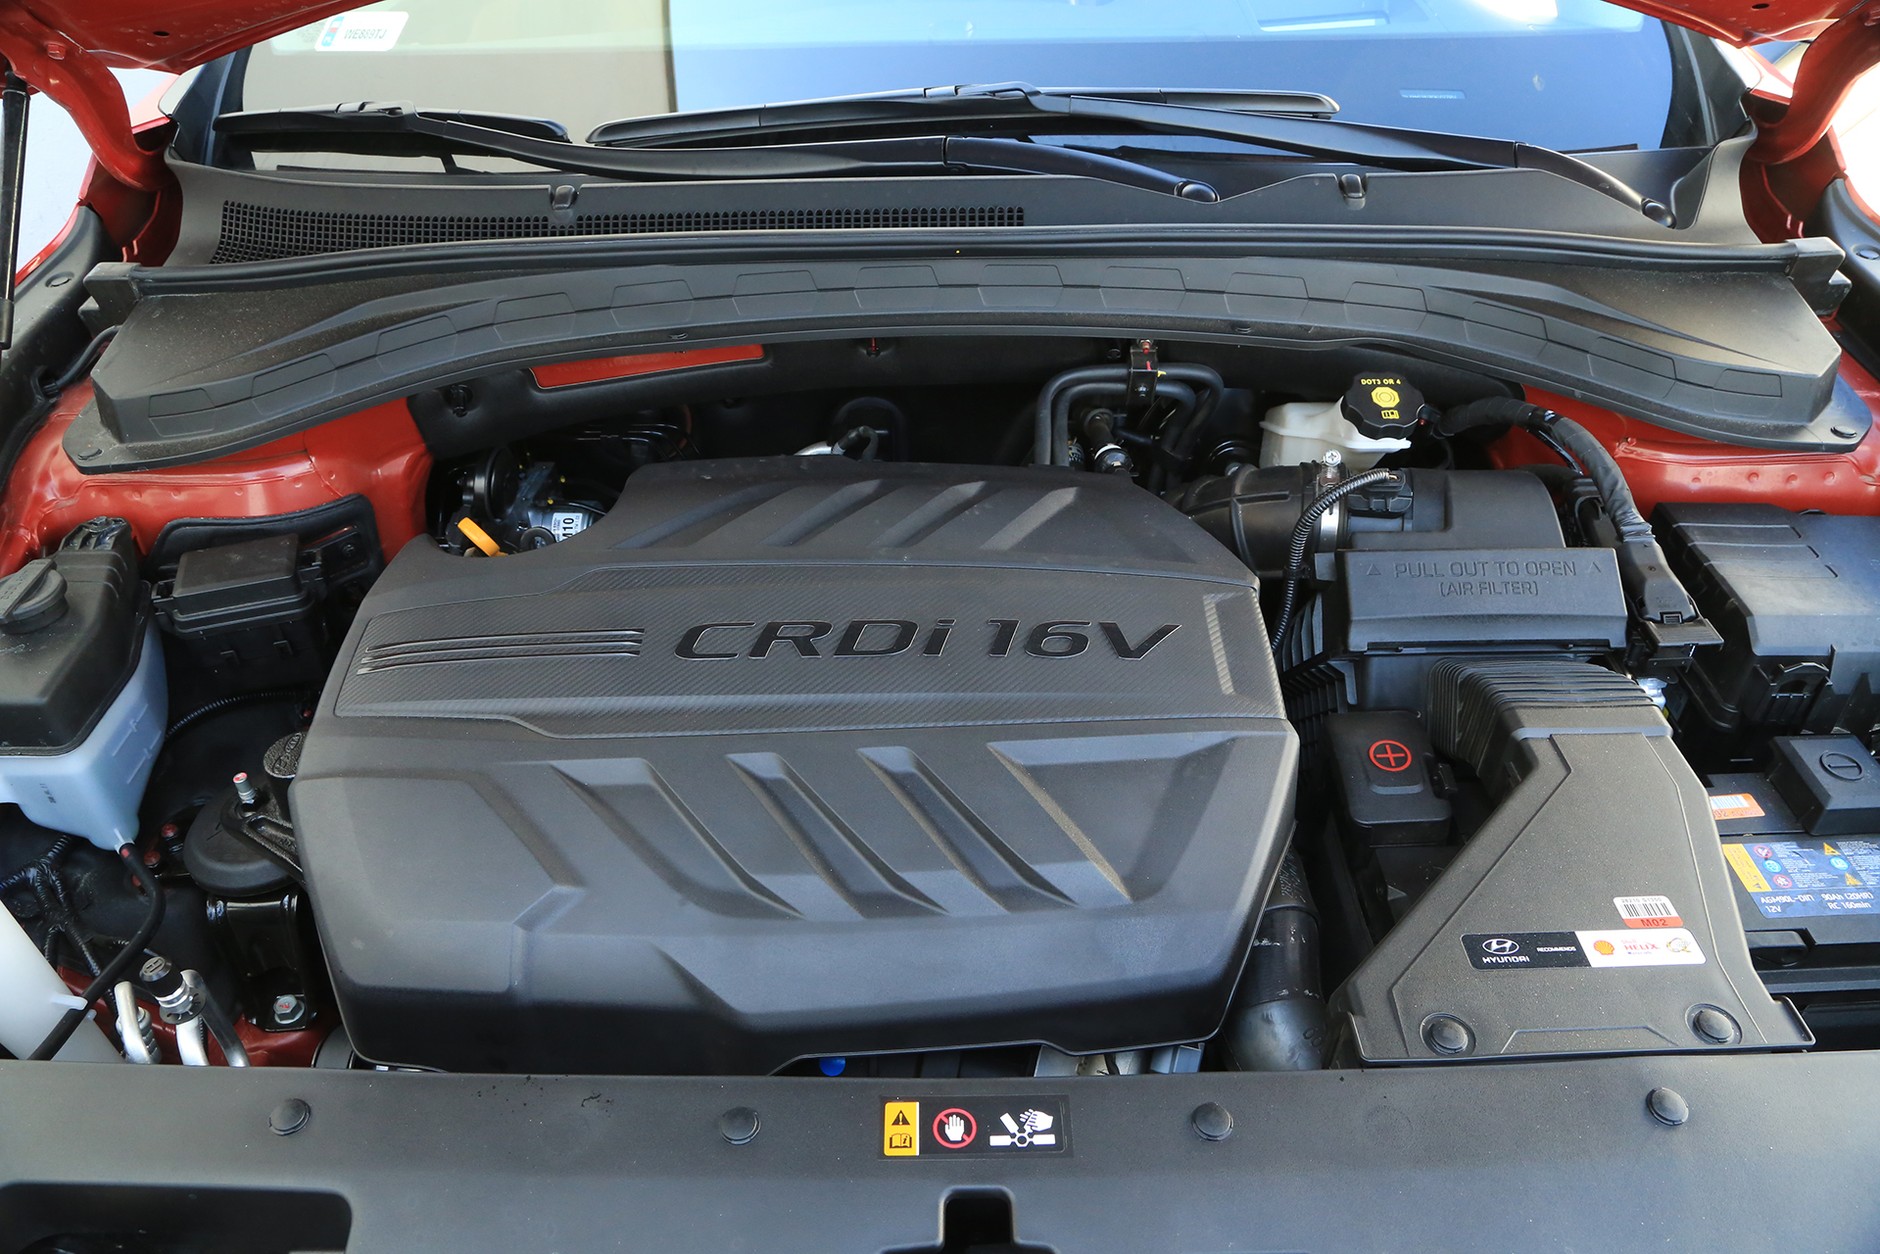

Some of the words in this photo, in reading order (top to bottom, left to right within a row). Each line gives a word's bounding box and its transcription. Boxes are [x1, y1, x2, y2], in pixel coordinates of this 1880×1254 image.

[1360, 378, 1381, 386] DOT3
[1394, 561, 1445, 579] PULL
[1450, 561, 1489, 578] OUT
[1495, 560, 1521, 577] TO
[1525, 560, 1577, 577] OPEN
[1439, 581, 1474, 597] (AIR
[1479, 580, 1539, 596] FILTER)
[673, 617, 957, 661] CRDi
[987, 618, 1183, 662] 16V
[1765, 905, 1782, 913] 12V
[1640, 918, 1669, 927] M02
[1624, 943, 1659, 951] HELIX
[1482, 955, 1531, 964] HYUNDAI
